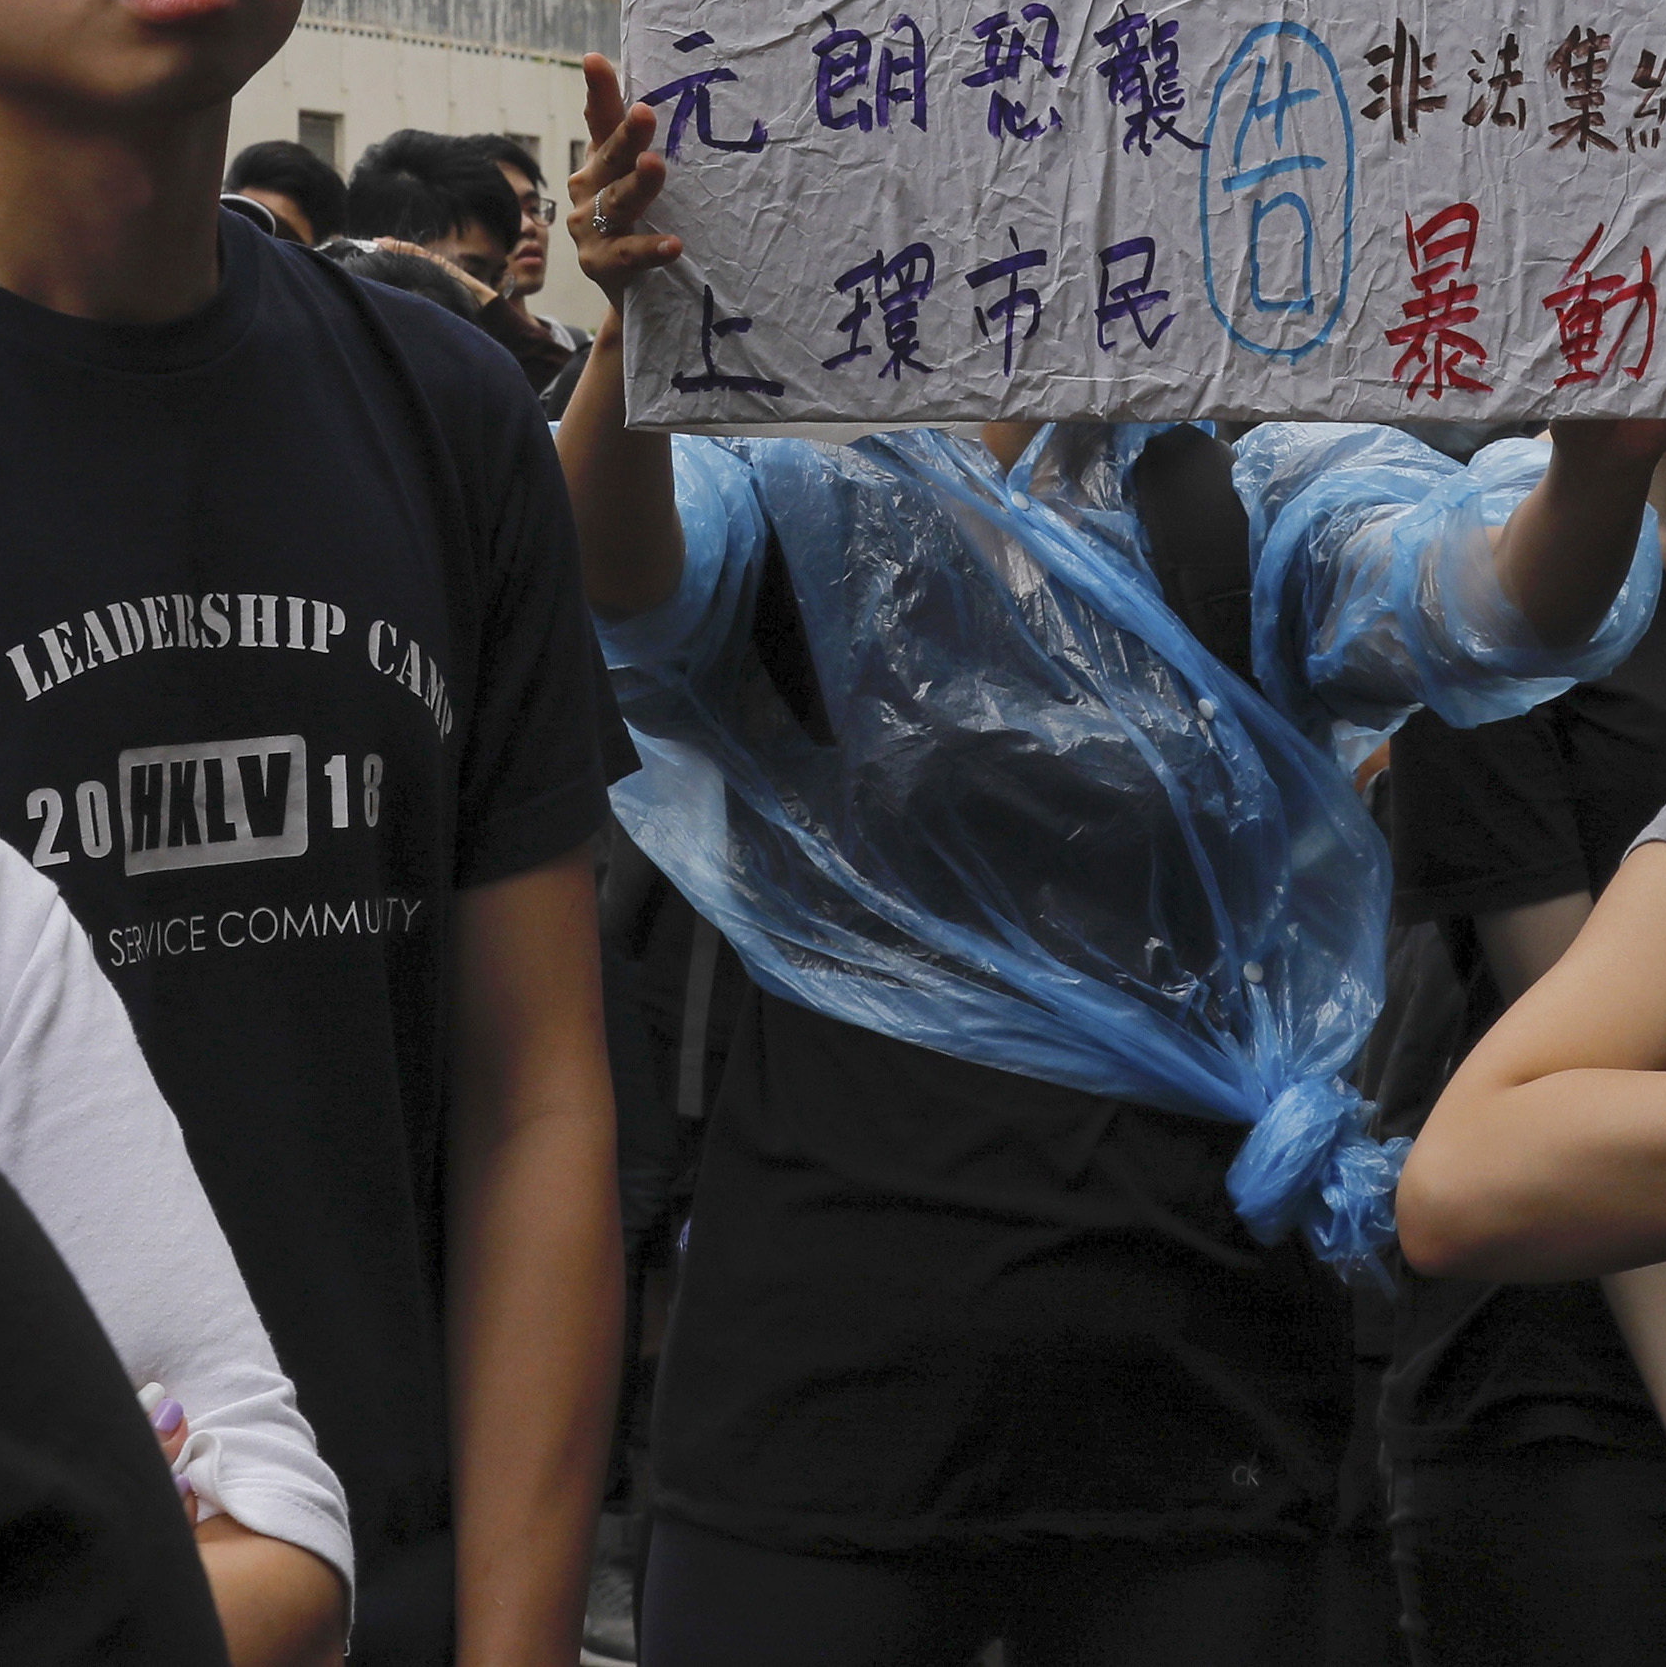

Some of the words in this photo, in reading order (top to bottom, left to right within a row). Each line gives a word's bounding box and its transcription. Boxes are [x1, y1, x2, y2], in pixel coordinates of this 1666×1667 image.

[670, 226, 1179, 396] 上環市民
[1384, 201, 1657, 401] 暴動
[5, 593, 347, 702] LEADERSHIP
[26, 780, 113, 868] 20
[130, 750, 291, 854] HKLV
[324, 753, 384, 829] 18
[108, 914, 206, 967] SERVICE
